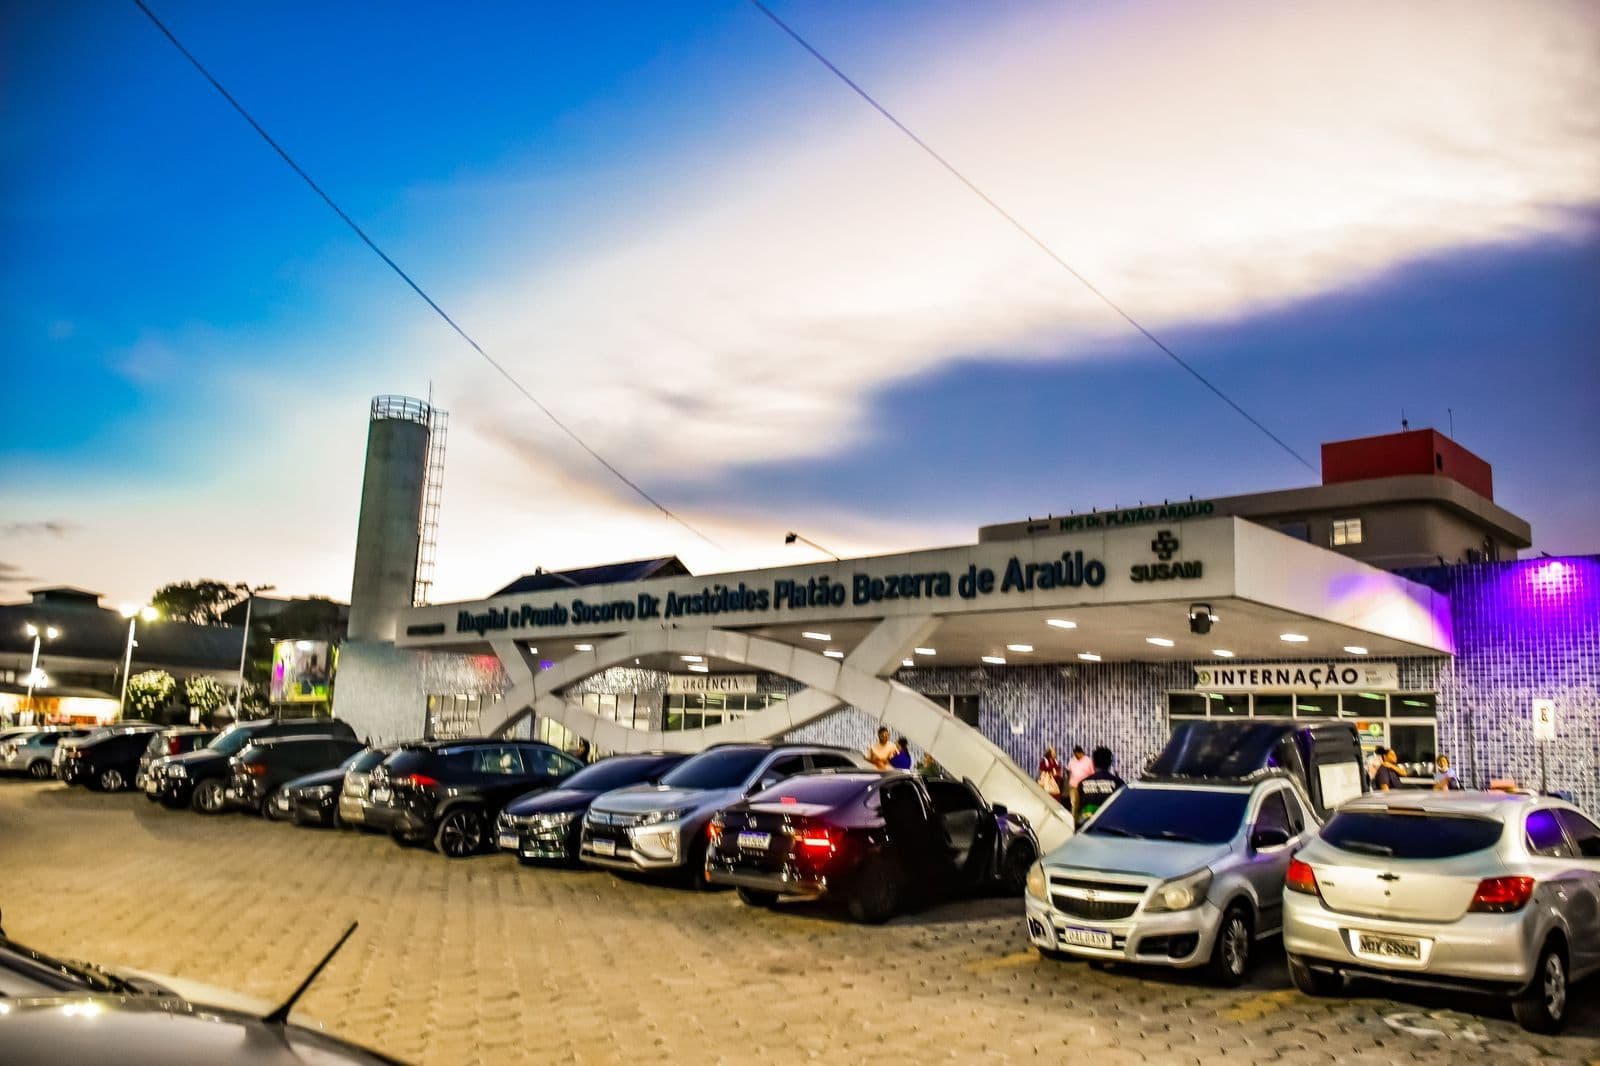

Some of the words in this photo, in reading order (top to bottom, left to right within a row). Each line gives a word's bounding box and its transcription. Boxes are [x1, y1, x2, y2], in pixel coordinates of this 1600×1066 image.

[1106, 506, 1155, 527] PLATÃO
[1129, 560, 1203, 583] SUSAM
[510, 611, 520, 628] e
[521, 602, 568, 628] Pronto
[571, 599, 635, 625] Socorro
[773, 575, 845, 610] Platão
[852, 570, 951, 605] Bezerra
[958, 563, 994, 599] de
[1214, 664, 1358, 689] INTERNAÇÃO
